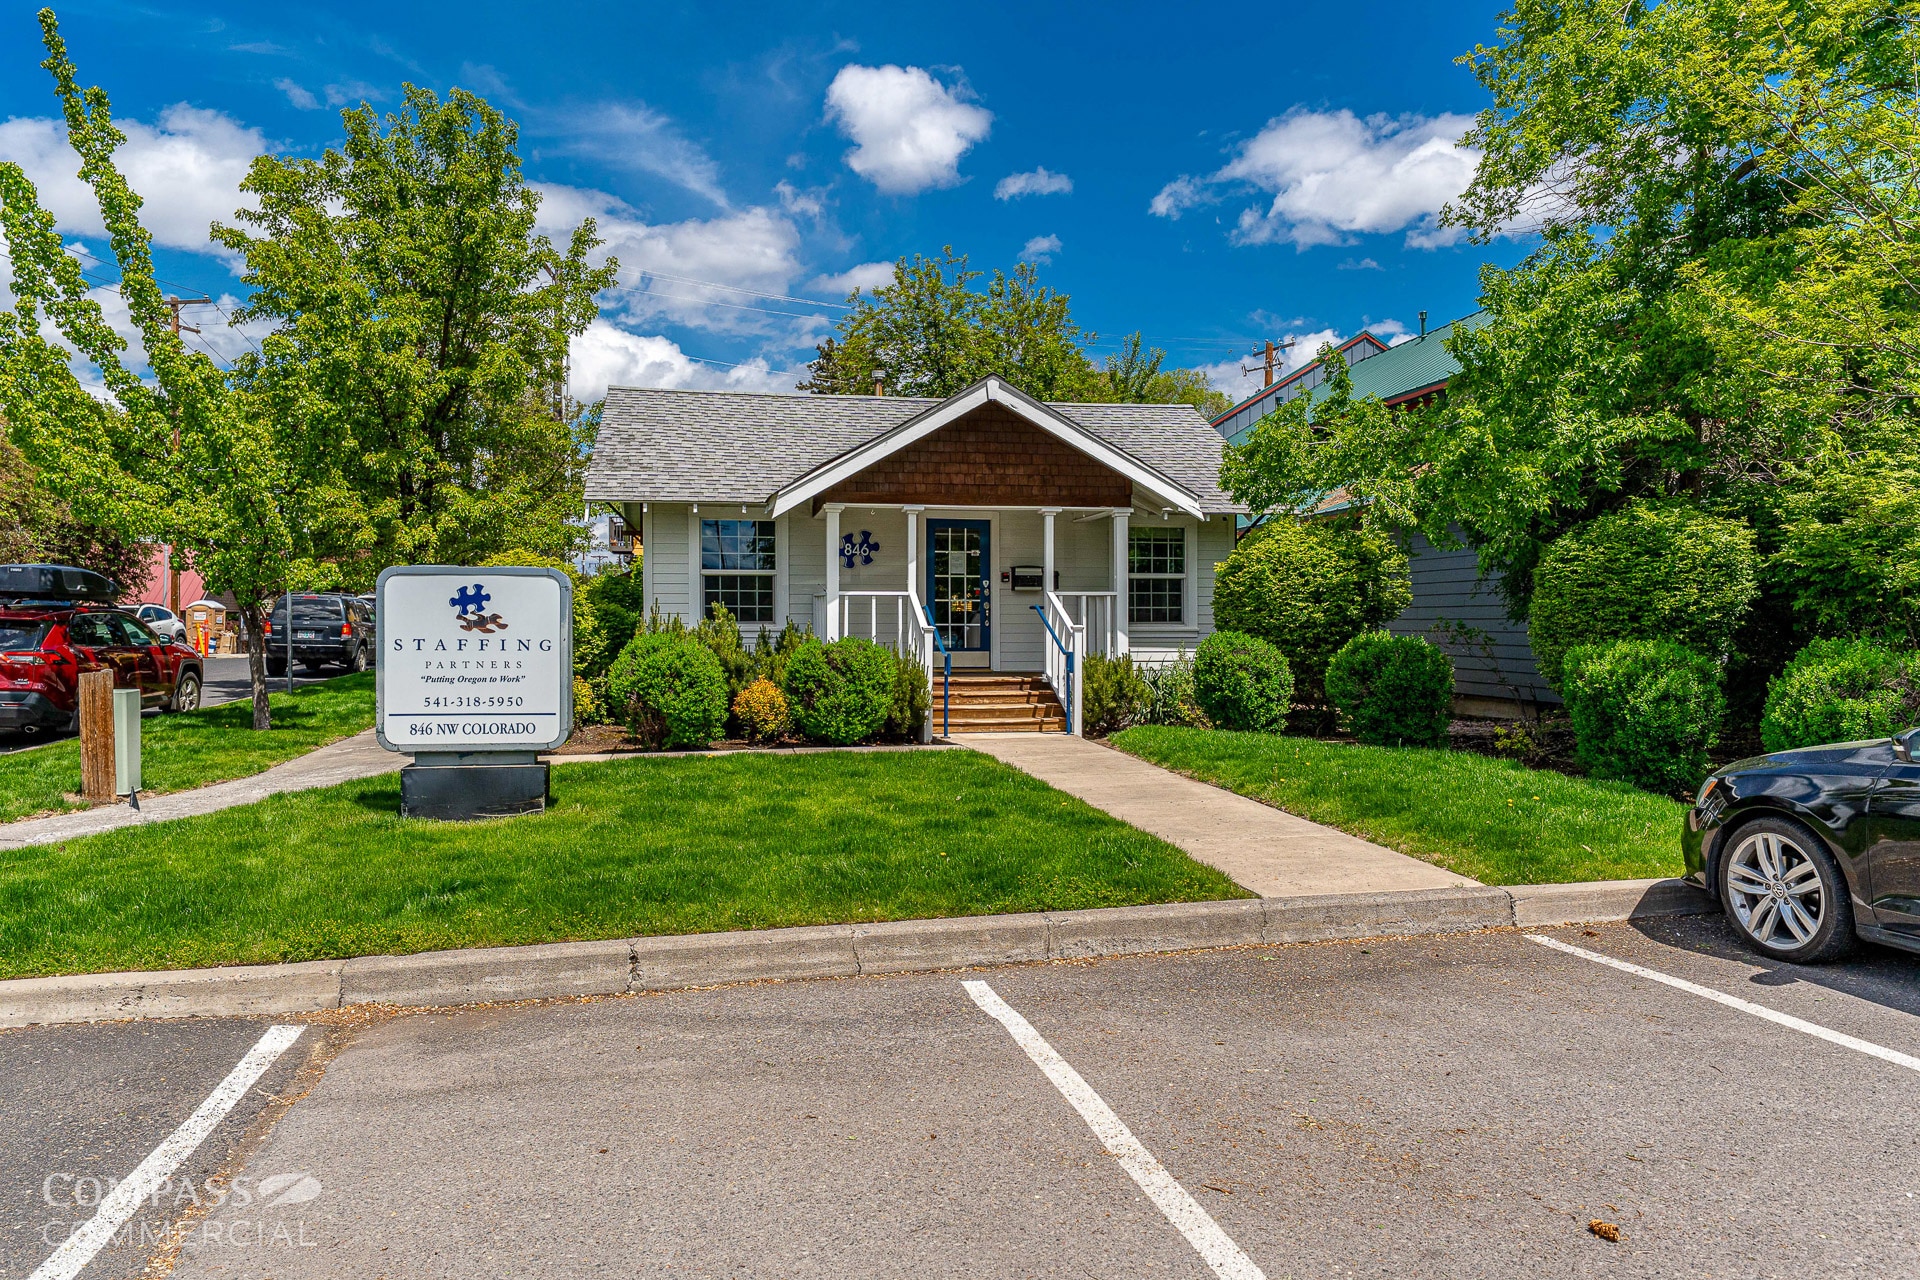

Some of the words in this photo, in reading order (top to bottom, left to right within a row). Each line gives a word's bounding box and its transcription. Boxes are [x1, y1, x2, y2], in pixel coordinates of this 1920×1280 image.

[844, 543, 869, 556] 846
[393, 638, 552, 652] STAFFING
[425, 660, 522, 669] PARTNERS
[457, 675, 487, 684] Oregon
[423, 696, 523, 707] 541-318-5950
[409, 722, 433, 736] 846
[436, 723, 459, 735] NW
[462, 722, 536, 735] COLORADO
